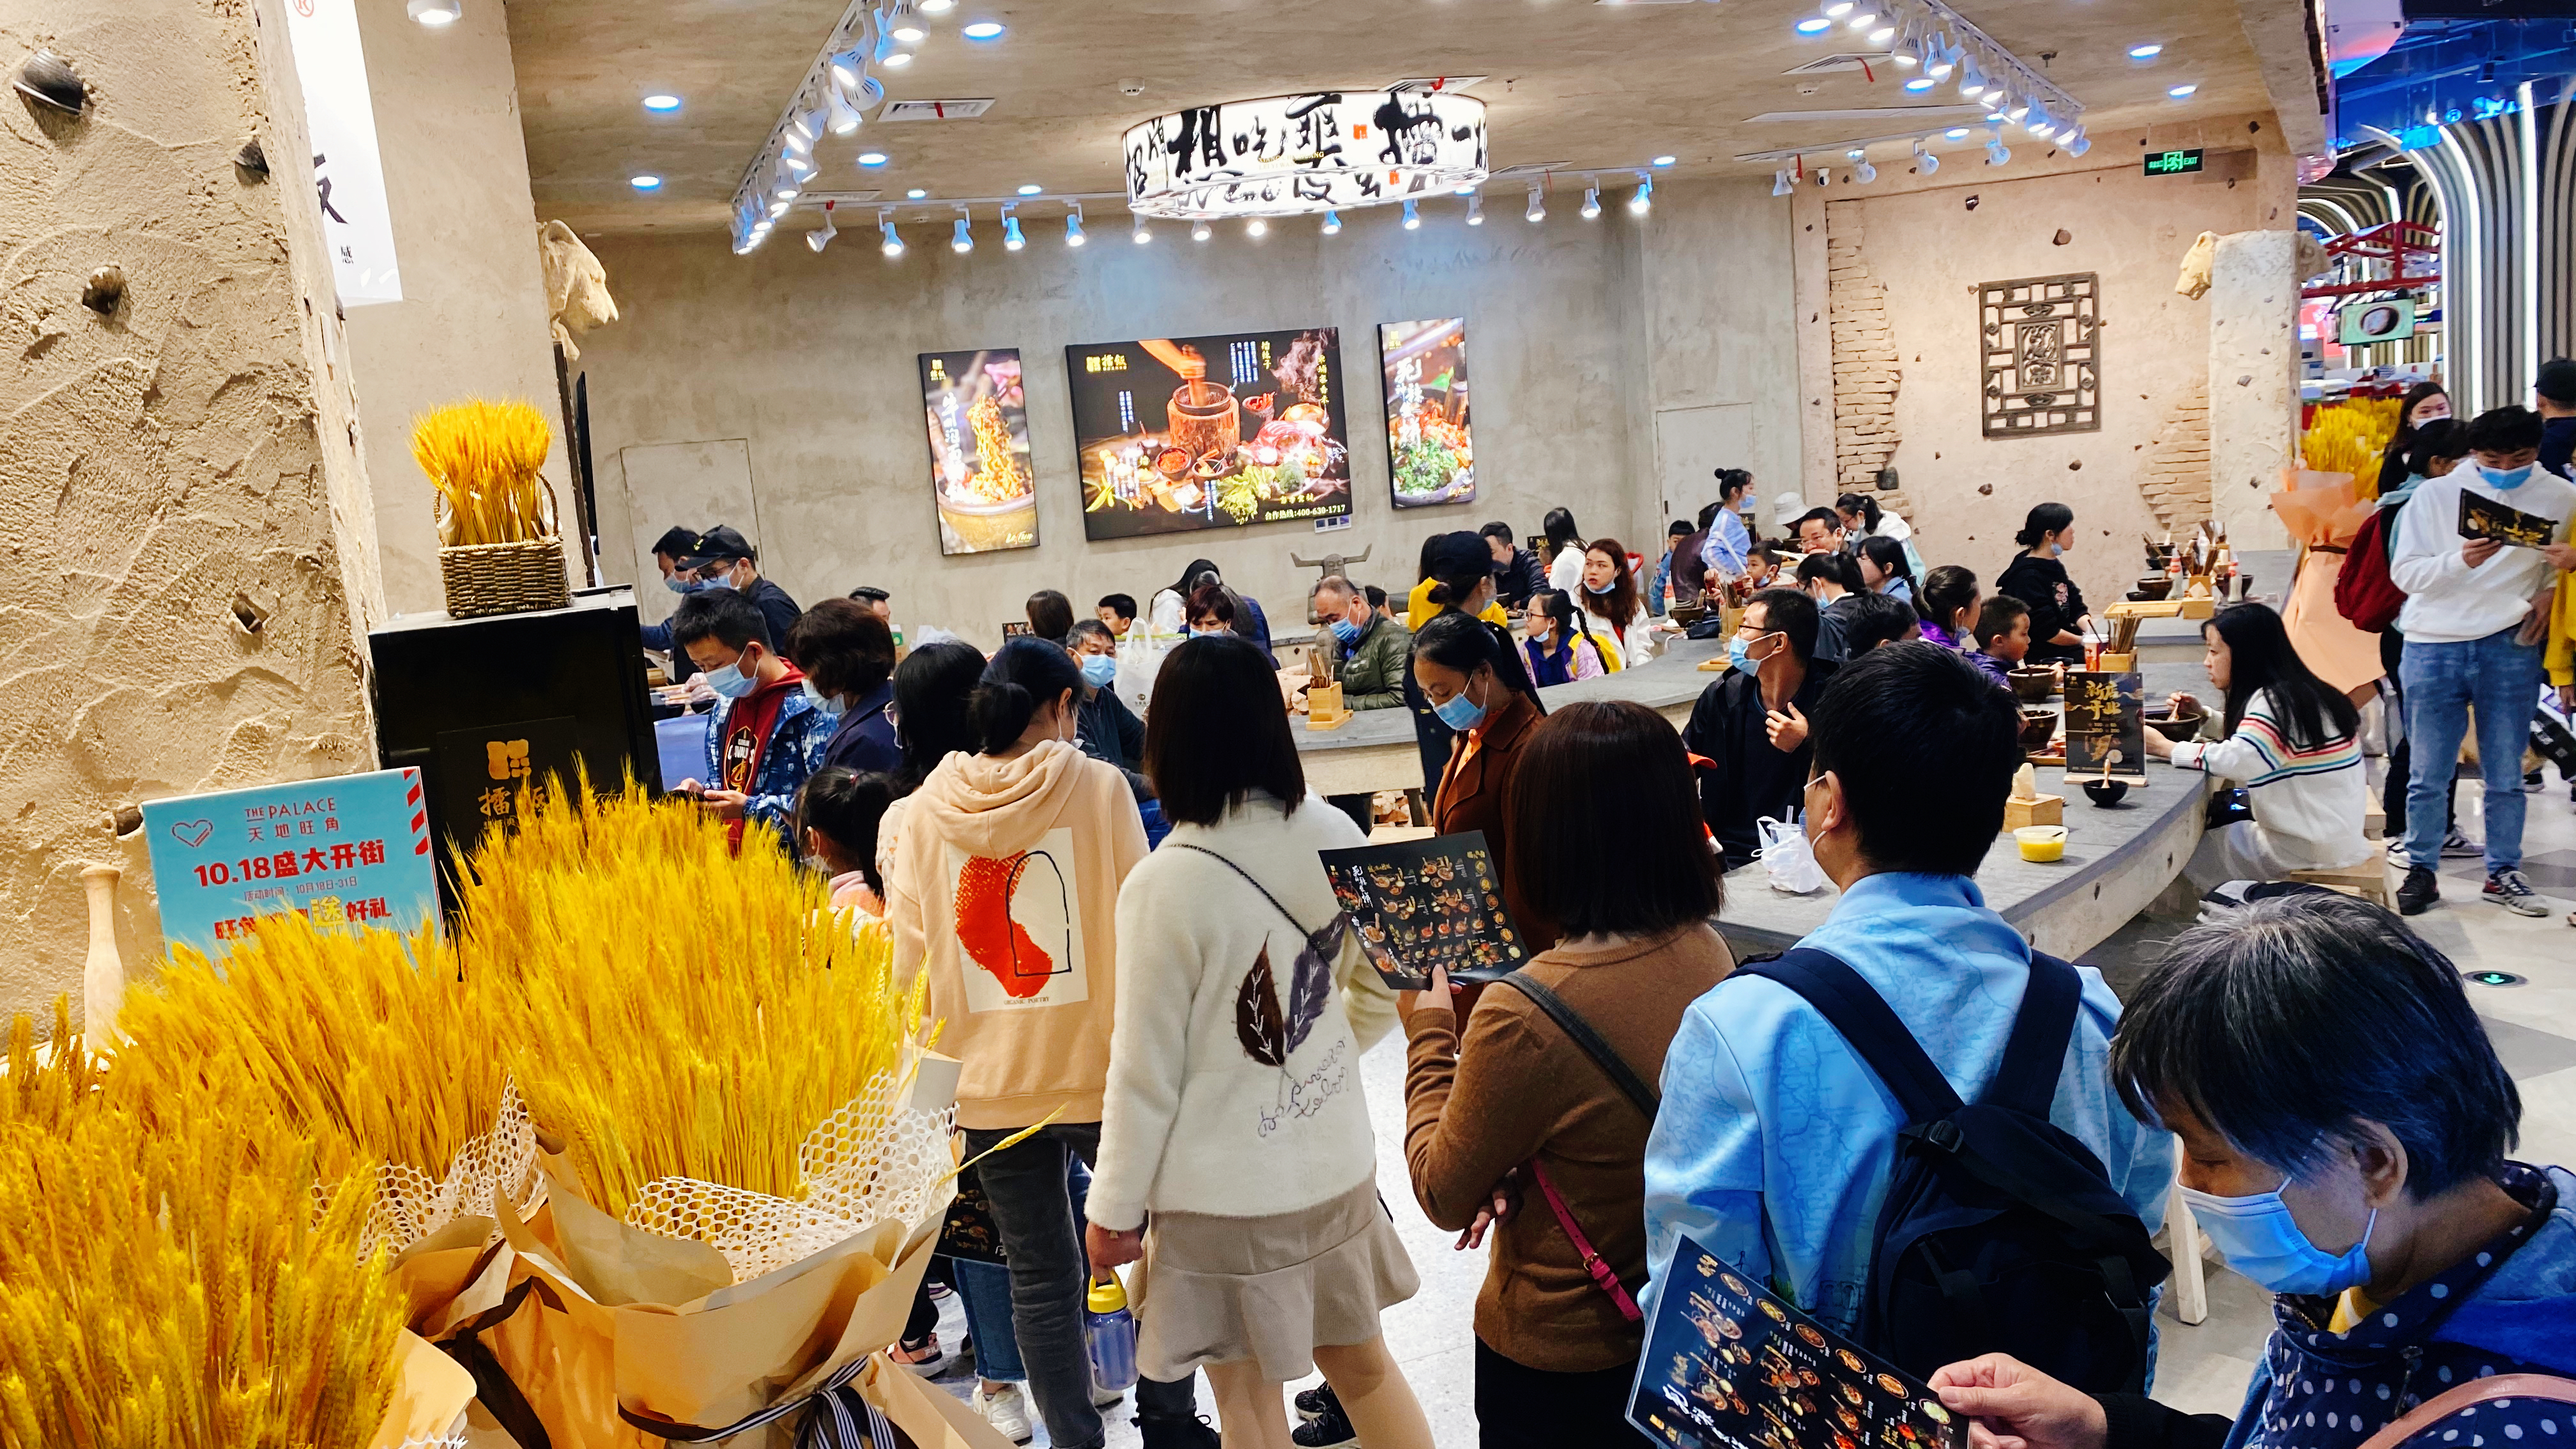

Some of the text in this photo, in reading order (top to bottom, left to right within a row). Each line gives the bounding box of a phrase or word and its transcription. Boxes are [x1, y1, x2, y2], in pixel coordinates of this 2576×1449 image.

[2184, 157, 2198, 165] EXIT
[245, 797, 336, 819] THE PALACE
[249, 817, 339, 843] 天地旺角
[194, 839, 385, 887] 10.18盛大开街
